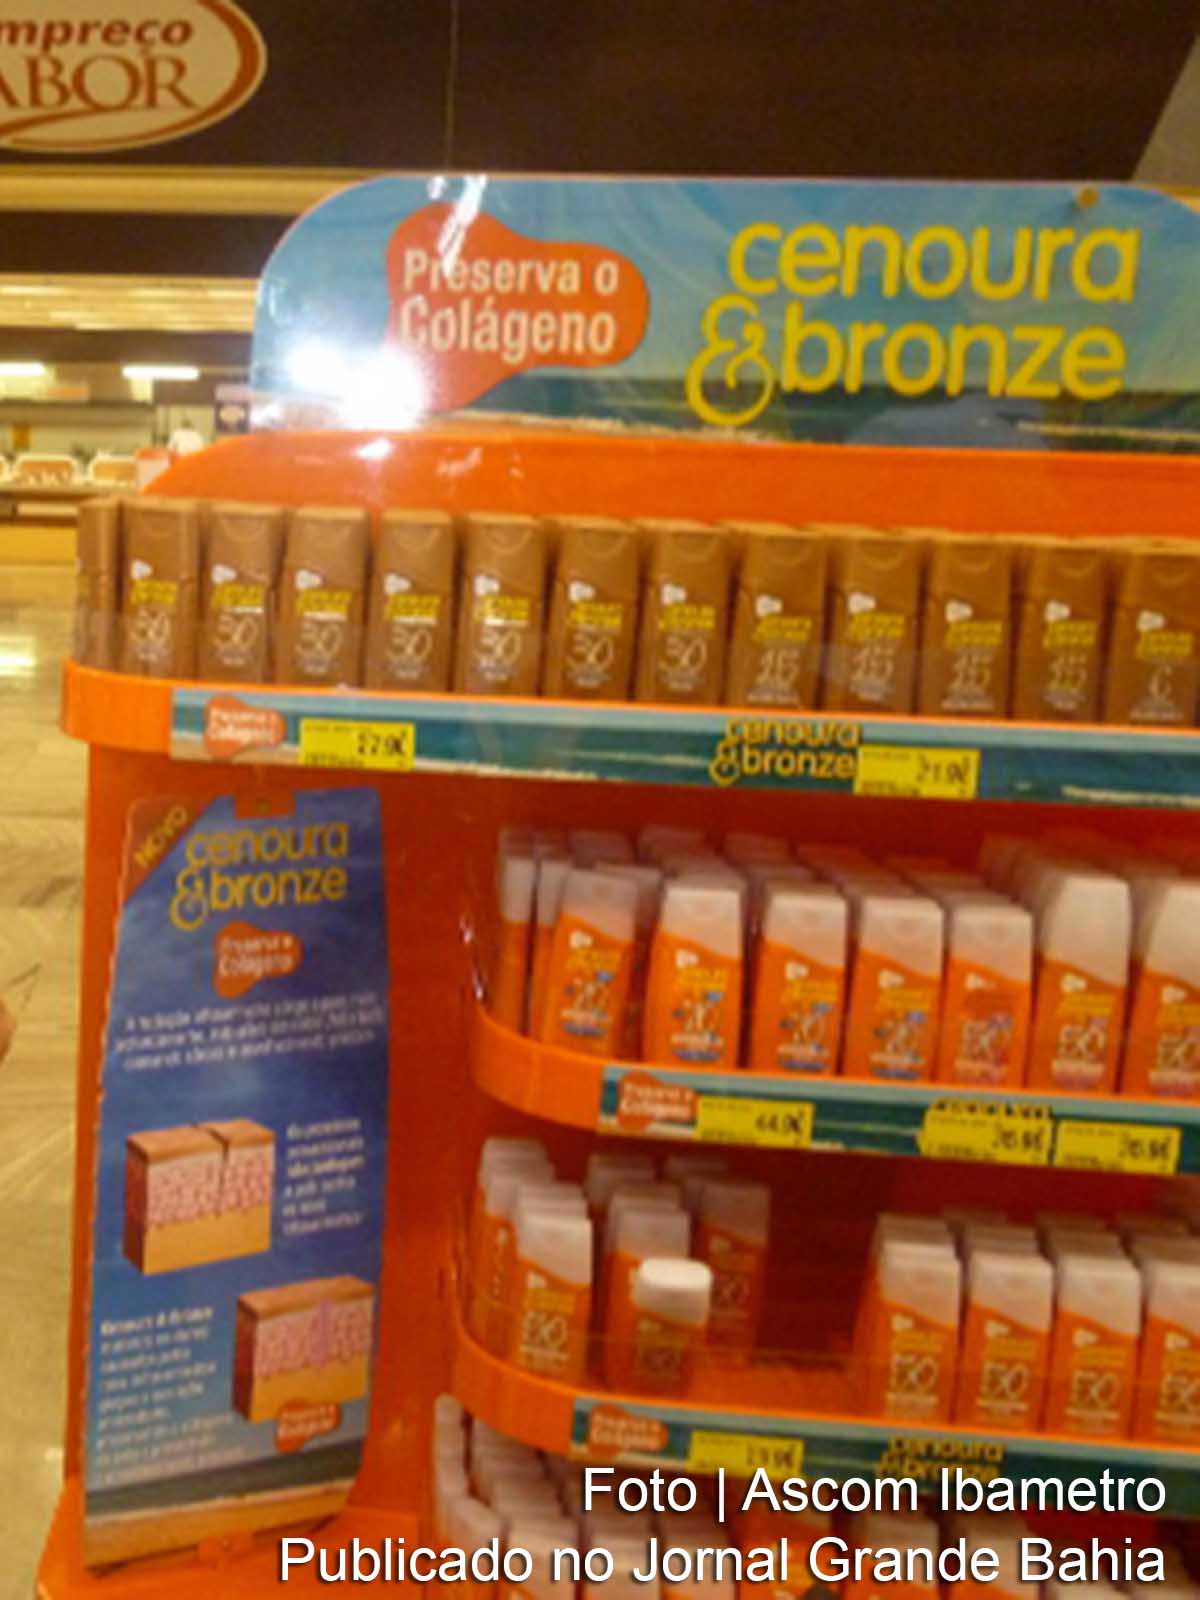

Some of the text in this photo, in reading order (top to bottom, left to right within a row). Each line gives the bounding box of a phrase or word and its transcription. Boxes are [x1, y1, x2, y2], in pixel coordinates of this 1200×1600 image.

[403, 247, 619, 295] Preserva o
[727, 222, 1141, 302] cenoura
[401, 293, 617, 364] Colágeno
[780, 303, 1127, 400] bronze
[723, 719, 864, 748] cenoura
[185, 822, 349, 868] cenoura
[211, 865, 348, 912] bronze
